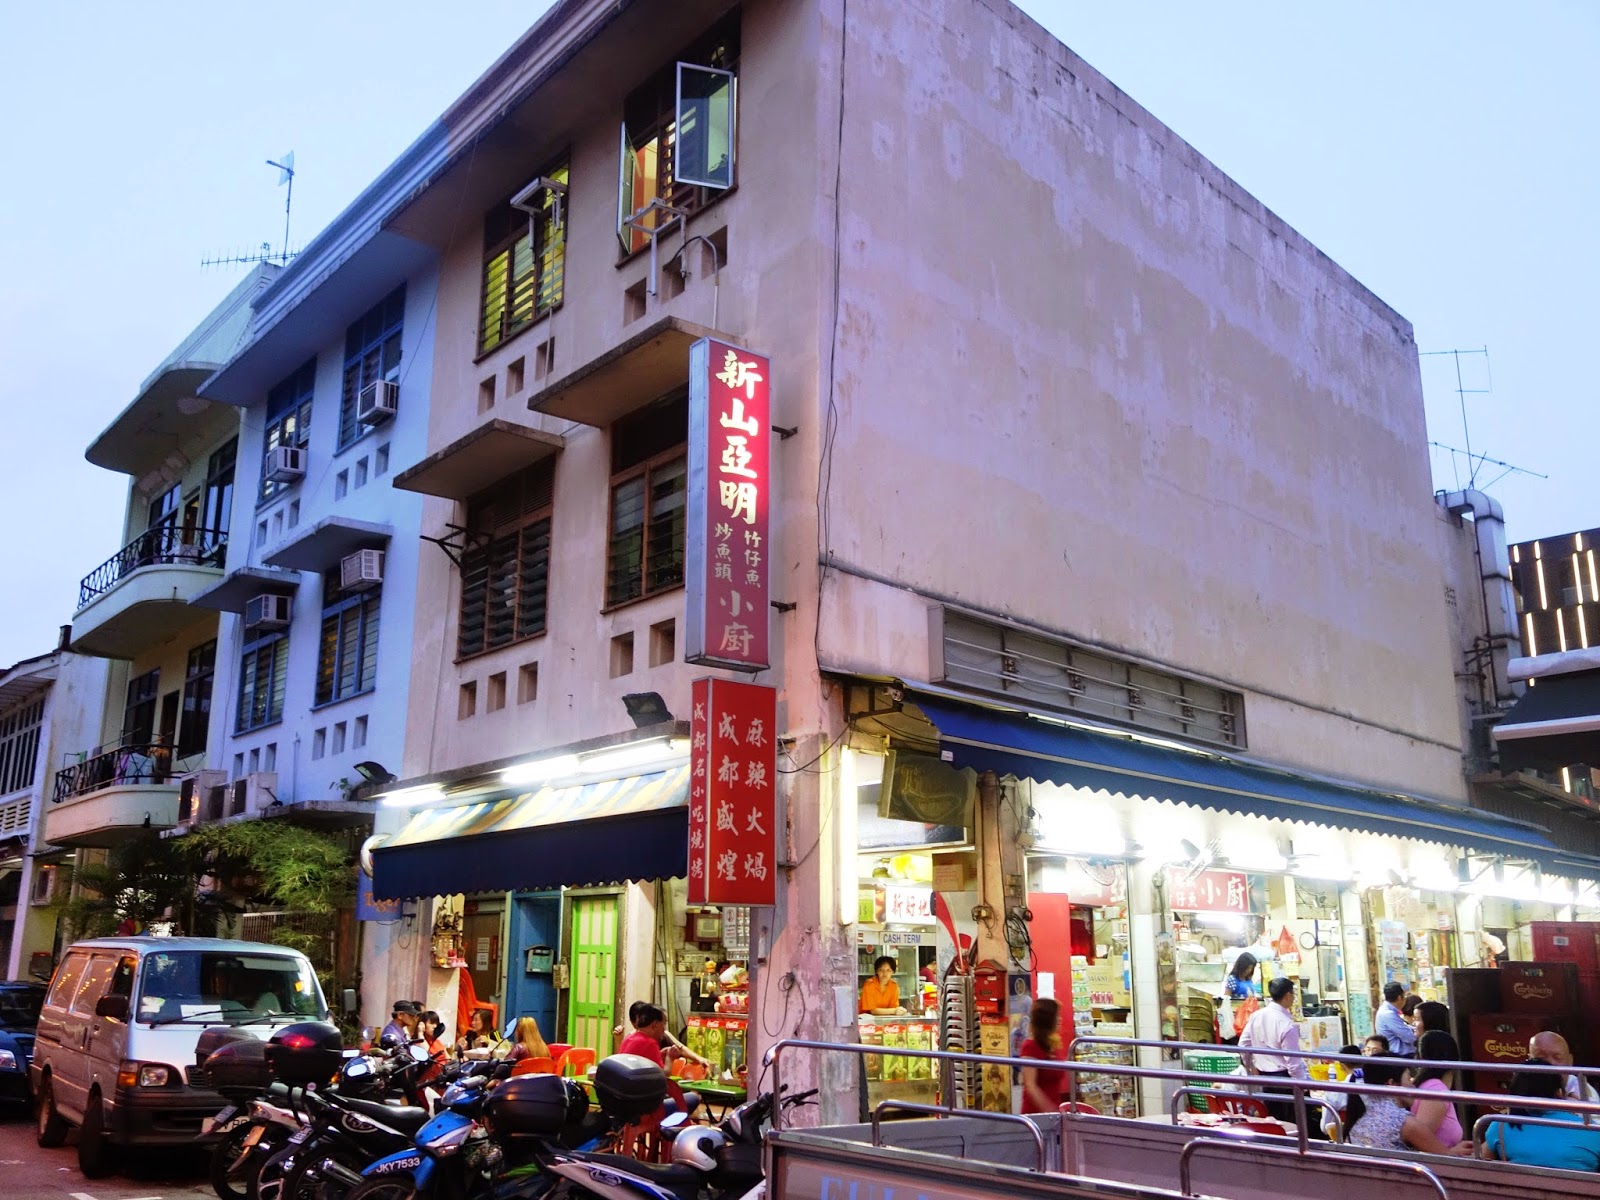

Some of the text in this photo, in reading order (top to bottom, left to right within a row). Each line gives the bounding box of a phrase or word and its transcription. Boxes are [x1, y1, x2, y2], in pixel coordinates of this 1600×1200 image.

[715, 350, 764, 525] 新山亞明
[714, 522, 734, 583] 炒魚頭
[719, 589, 754, 657] 小廚
[716, 711, 739, 881] 成都盛煌
[1200, 875, 1246, 910] 小廚
[883, 933, 921, 945] CASH TERM
[1513, 982, 1553, 999] Carlsberg
[1484, 1039, 1528, 1058] Carlsberg
[376, 1157, 420, 1173] JKY7533
